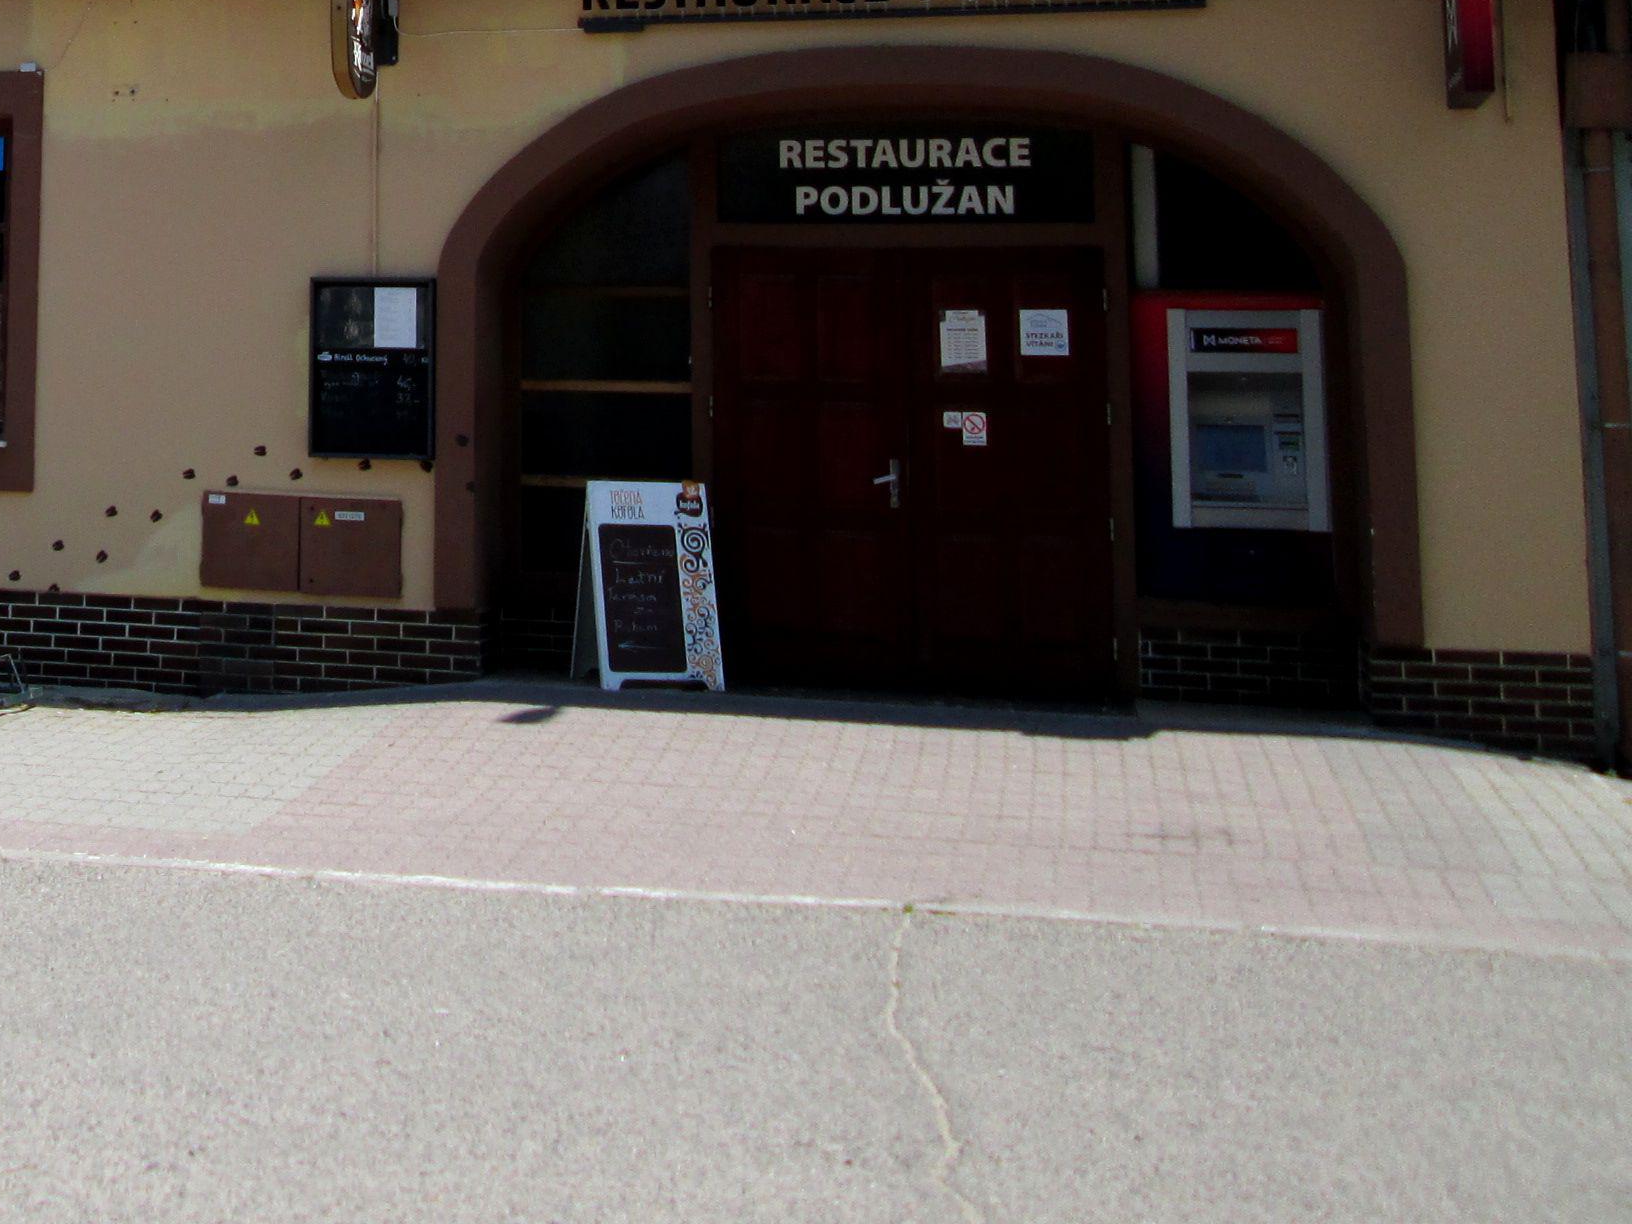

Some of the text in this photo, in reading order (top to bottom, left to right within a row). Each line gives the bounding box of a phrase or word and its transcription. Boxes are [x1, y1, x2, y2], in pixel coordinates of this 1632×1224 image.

[778, 137, 1032, 169] RESTAURACE
[795, 178, 1016, 216] PODLUŽAN
[1217, 335, 1263, 345] MONETA
